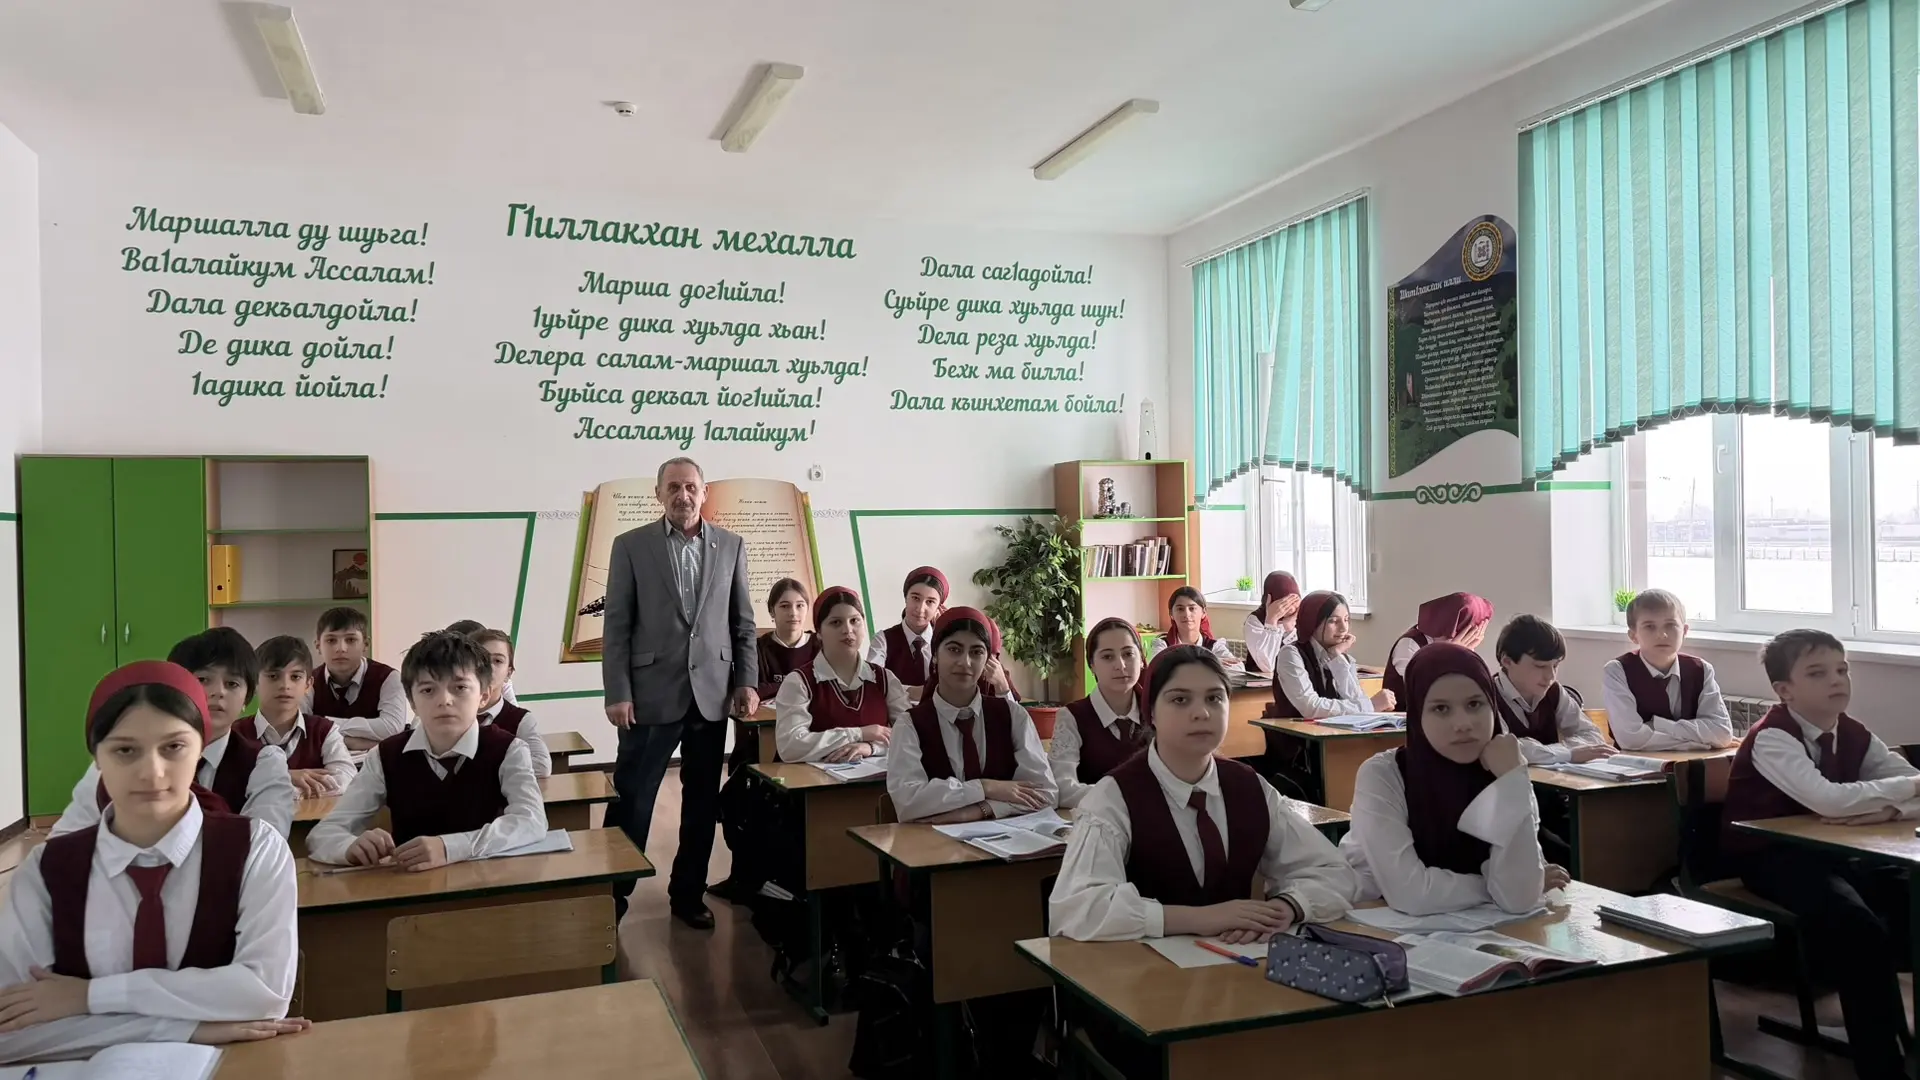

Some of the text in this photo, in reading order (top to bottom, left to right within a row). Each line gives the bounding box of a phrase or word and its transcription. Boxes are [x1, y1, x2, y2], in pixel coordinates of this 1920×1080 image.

[126, 206, 428, 254] Маршалла ду шуьга!
[713, 230, 857, 259] мехалла
[121, 247, 434, 288] Ва1алайкум Ассалам!
[920, 256, 975, 279] Дала
[578, 271, 785, 308] Марша дог1ийла!
[146, 289, 418, 330] Дала декъалдойла!
[884, 289, 1125, 327] Суьйре дика хуьлда шун!
[618, 317, 675, 342] дика
[683, 319, 762, 346] хуьлда
[768, 319, 826, 340] хьан!
[918, 324, 1097, 358] Дела реза хуьлда!
[178, 330, 394, 368] Де дика дойла!
[494, 341, 868, 385] Делера салам-маршал хуьлда!
[296, 374, 388, 398] йойла!
[932, 358, 1084, 381] Бехк ма билла!
[538, 380, 822, 414] Буьйса декъал йог1ийла!
[890, 389, 1124, 413] Дала къинхетам бойла!
[573, 417, 695, 450] Ассаламу
